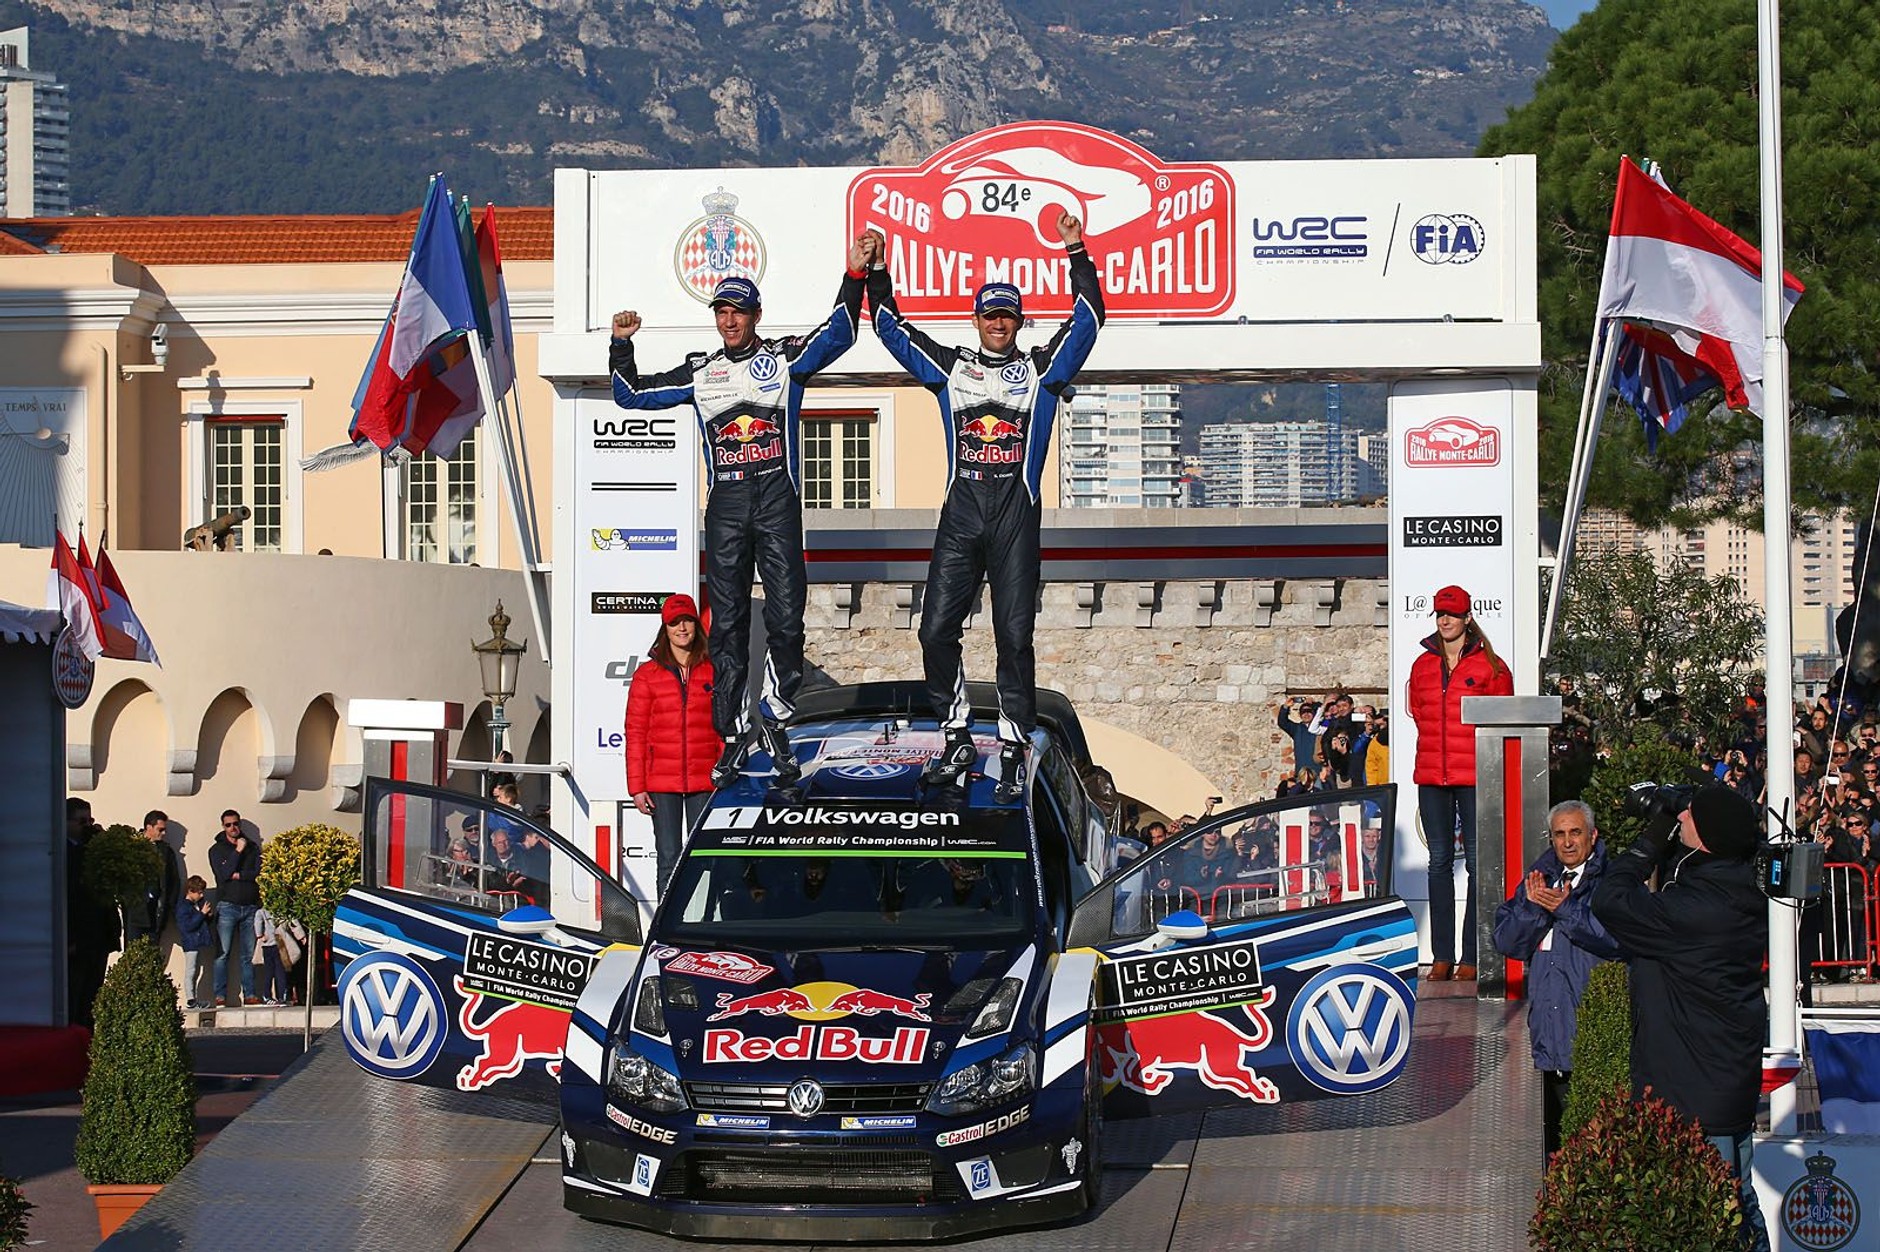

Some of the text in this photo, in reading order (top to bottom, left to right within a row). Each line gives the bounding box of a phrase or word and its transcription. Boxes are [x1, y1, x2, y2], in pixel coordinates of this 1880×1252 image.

[871, 183, 931, 234] 2016
[1156, 179, 1214, 229] 2016
[1253, 217, 1367, 240] WRC
[986, 219, 1215, 295] MONT-CARLO
[4, 402, 66, 412] TEMPS VRAI
[594, 419, 675, 436] WRC
[716, 438, 782, 465] Red Bull
[959, 441, 1022, 463] Red Bull
[1410, 441, 1495, 461] RALLYE MONTE-CARLO
[1406, 519, 1500, 534] LE CASINO
[596, 596, 657, 605] CERTINA
[729, 807, 959, 829] 1 Volkswagen
[755, 836, 775, 845] FIA
[779, 836, 814, 845] World
[817, 836, 848, 846] Rally
[852, 836, 938, 846] Championship
[472, 937, 584, 978] LE CASINO
[1123, 949, 1251, 985] LE CASINO
[493, 984, 504, 993] FIA
[505, 985, 524, 996] World
[525, 989, 541, 1001] Rally
[1126, 1006, 1147, 1015] World
[1150, 1003, 1167, 1013] Rally
[1169, 995, 1219, 1010] Championship
[703, 1025, 930, 1064] Red Bull
[630, 1118, 678, 1145] EDGE
[718, 1116, 768, 1126] MICHELIN
[864, 1117, 914, 1126] MICHELIN
[948, 1104, 1031, 1144] Castrol EDGE
